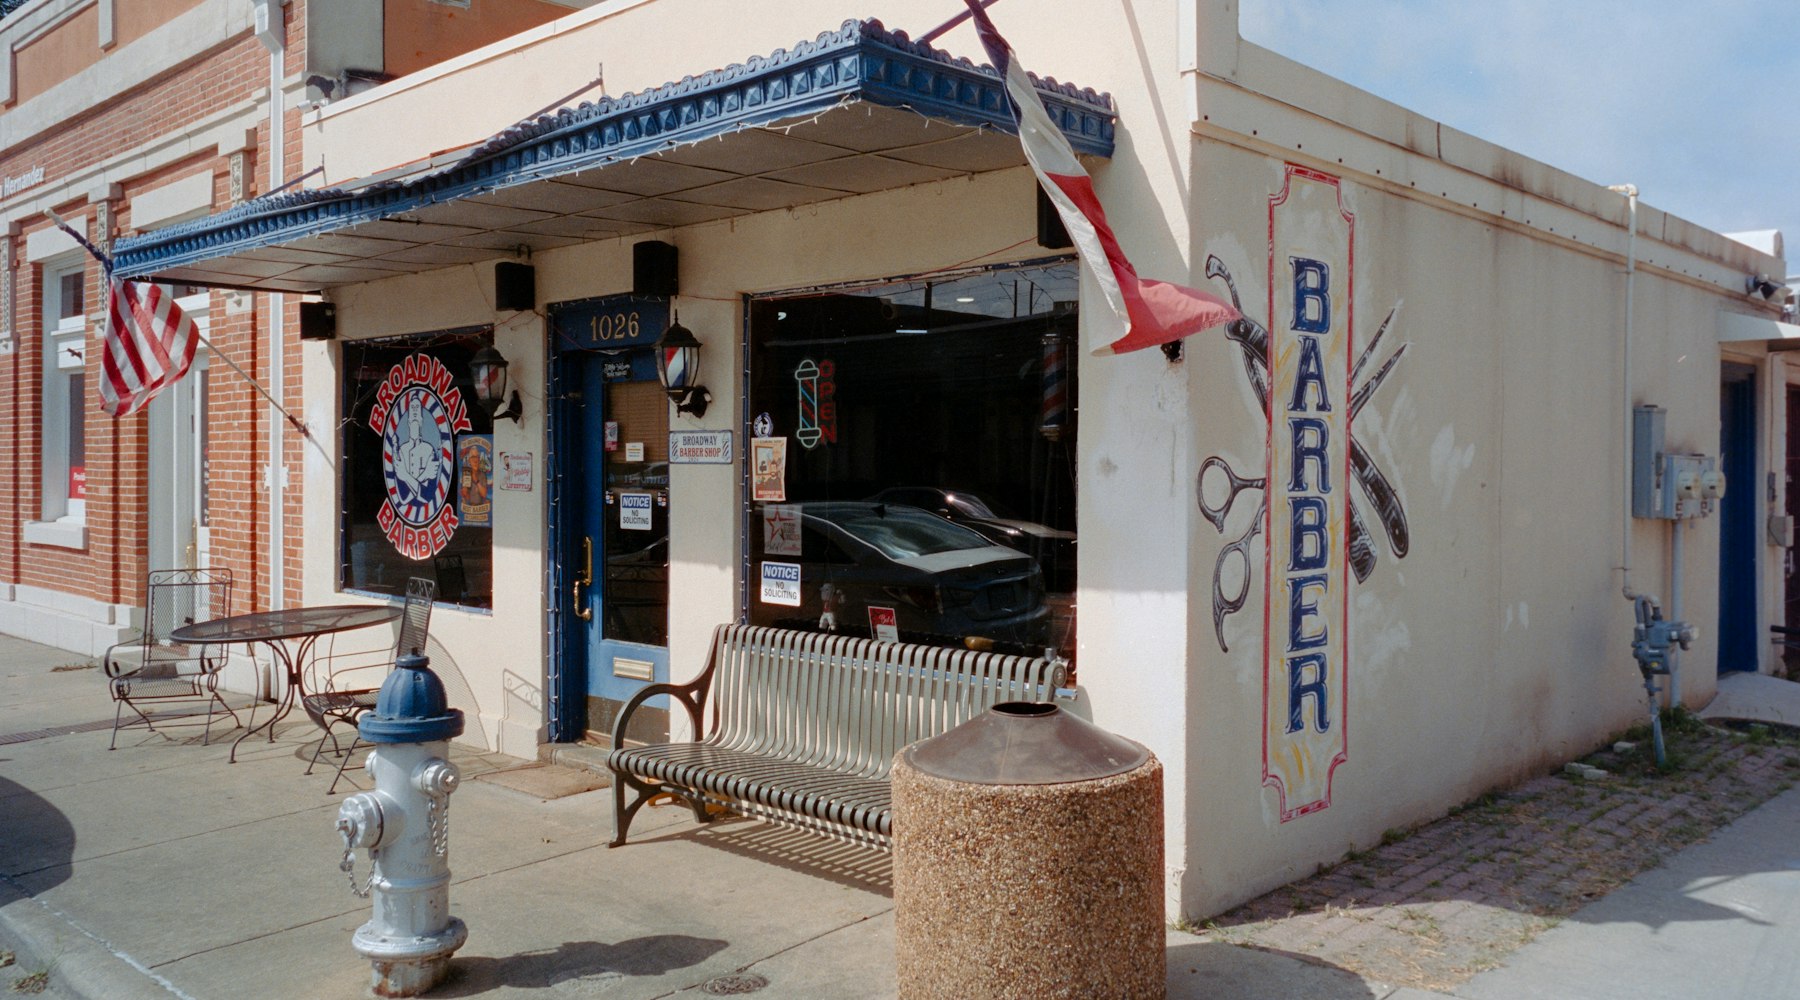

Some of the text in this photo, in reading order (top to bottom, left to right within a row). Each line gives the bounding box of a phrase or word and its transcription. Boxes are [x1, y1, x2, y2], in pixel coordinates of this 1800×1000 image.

[4, 164, 45, 197] Hernandez
[591, 312, 640, 341] 1026
[368, 353, 473, 437] BROADWAY
[819, 360, 837, 444] OPEN
[682, 435, 718, 446] BROADWAY
[679, 447, 722, 458] BARBER SHOP
[622, 496, 650, 508] NOTICE
[1285, 255, 1332, 735] BARBER
[622, 516, 650, 526] SOLICITING
[376, 498, 460, 561] BARBER
[764, 565, 799, 580] NOTICE
[776, 582, 785, 590] NO
[764, 589, 797, 600] SOLICITING
